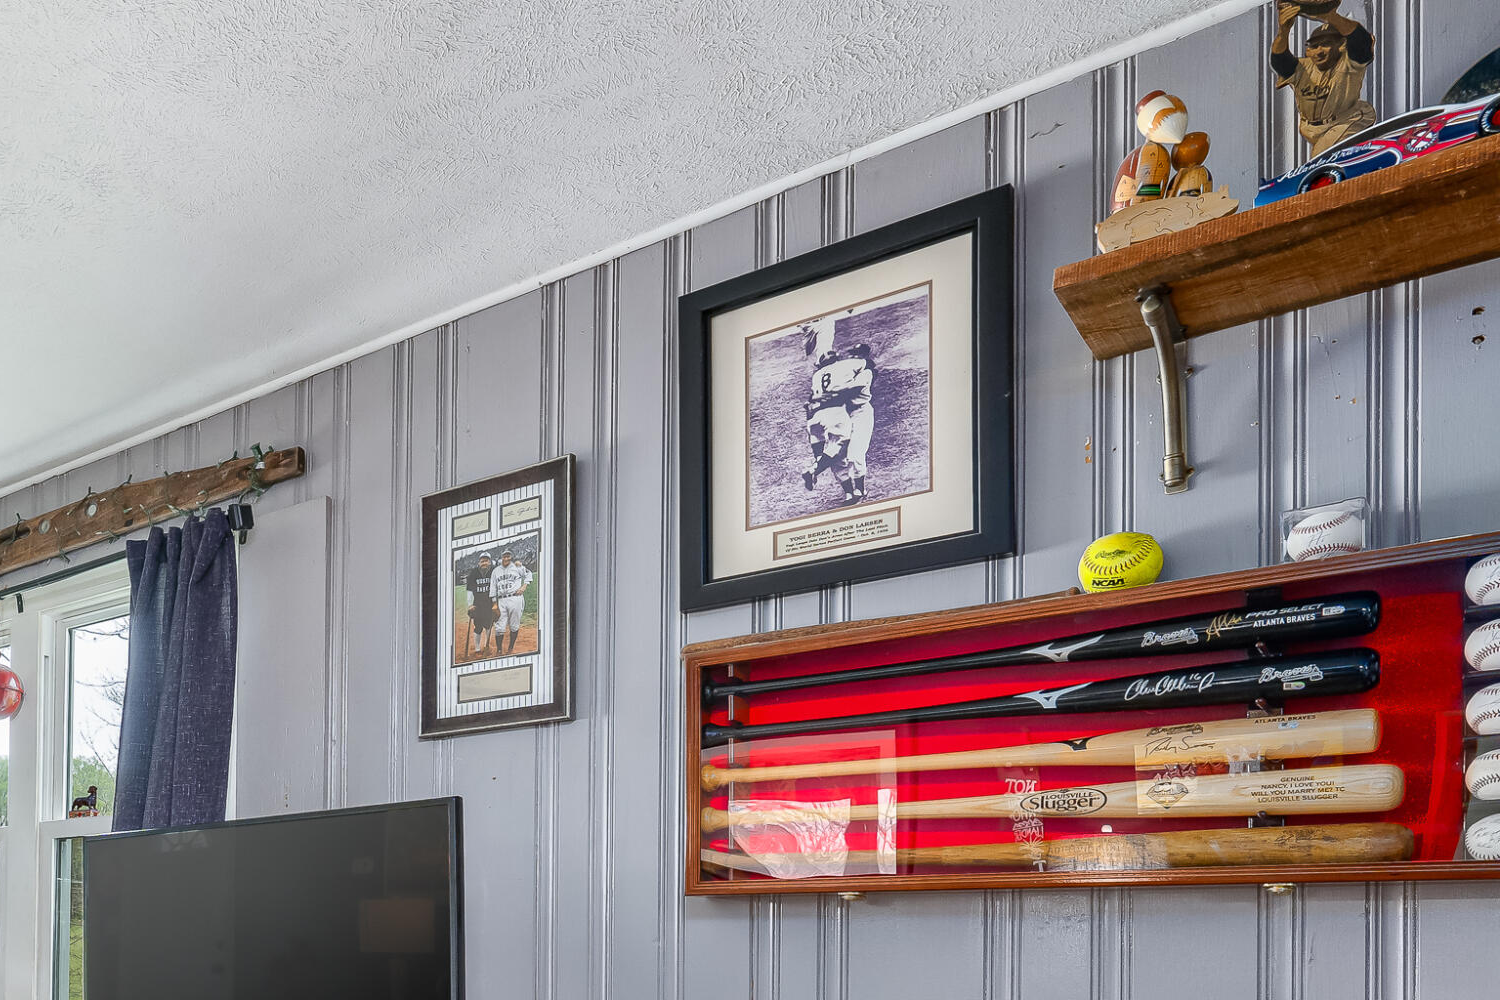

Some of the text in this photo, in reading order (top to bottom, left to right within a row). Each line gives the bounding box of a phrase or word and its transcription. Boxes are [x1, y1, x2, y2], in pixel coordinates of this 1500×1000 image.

[789, 535, 806, 543] YOGI
[807, 530, 830, 539] BERRA
[839, 524, 854, 532] DON
[855, 519, 884, 528] LARSEN
[1092, 578, 1125, 586] NCAA
[1246, 602, 1325, 619] PRO SELECT
[1252, 613, 1316, 629] ATLANTA BRAVES
[1140, 626, 1199, 647] Braves
[1258, 663, 1324, 684] Braves
[1044, 791, 1094, 800] LOUISVILLE
[1029, 796, 1097, 812] Slugger
